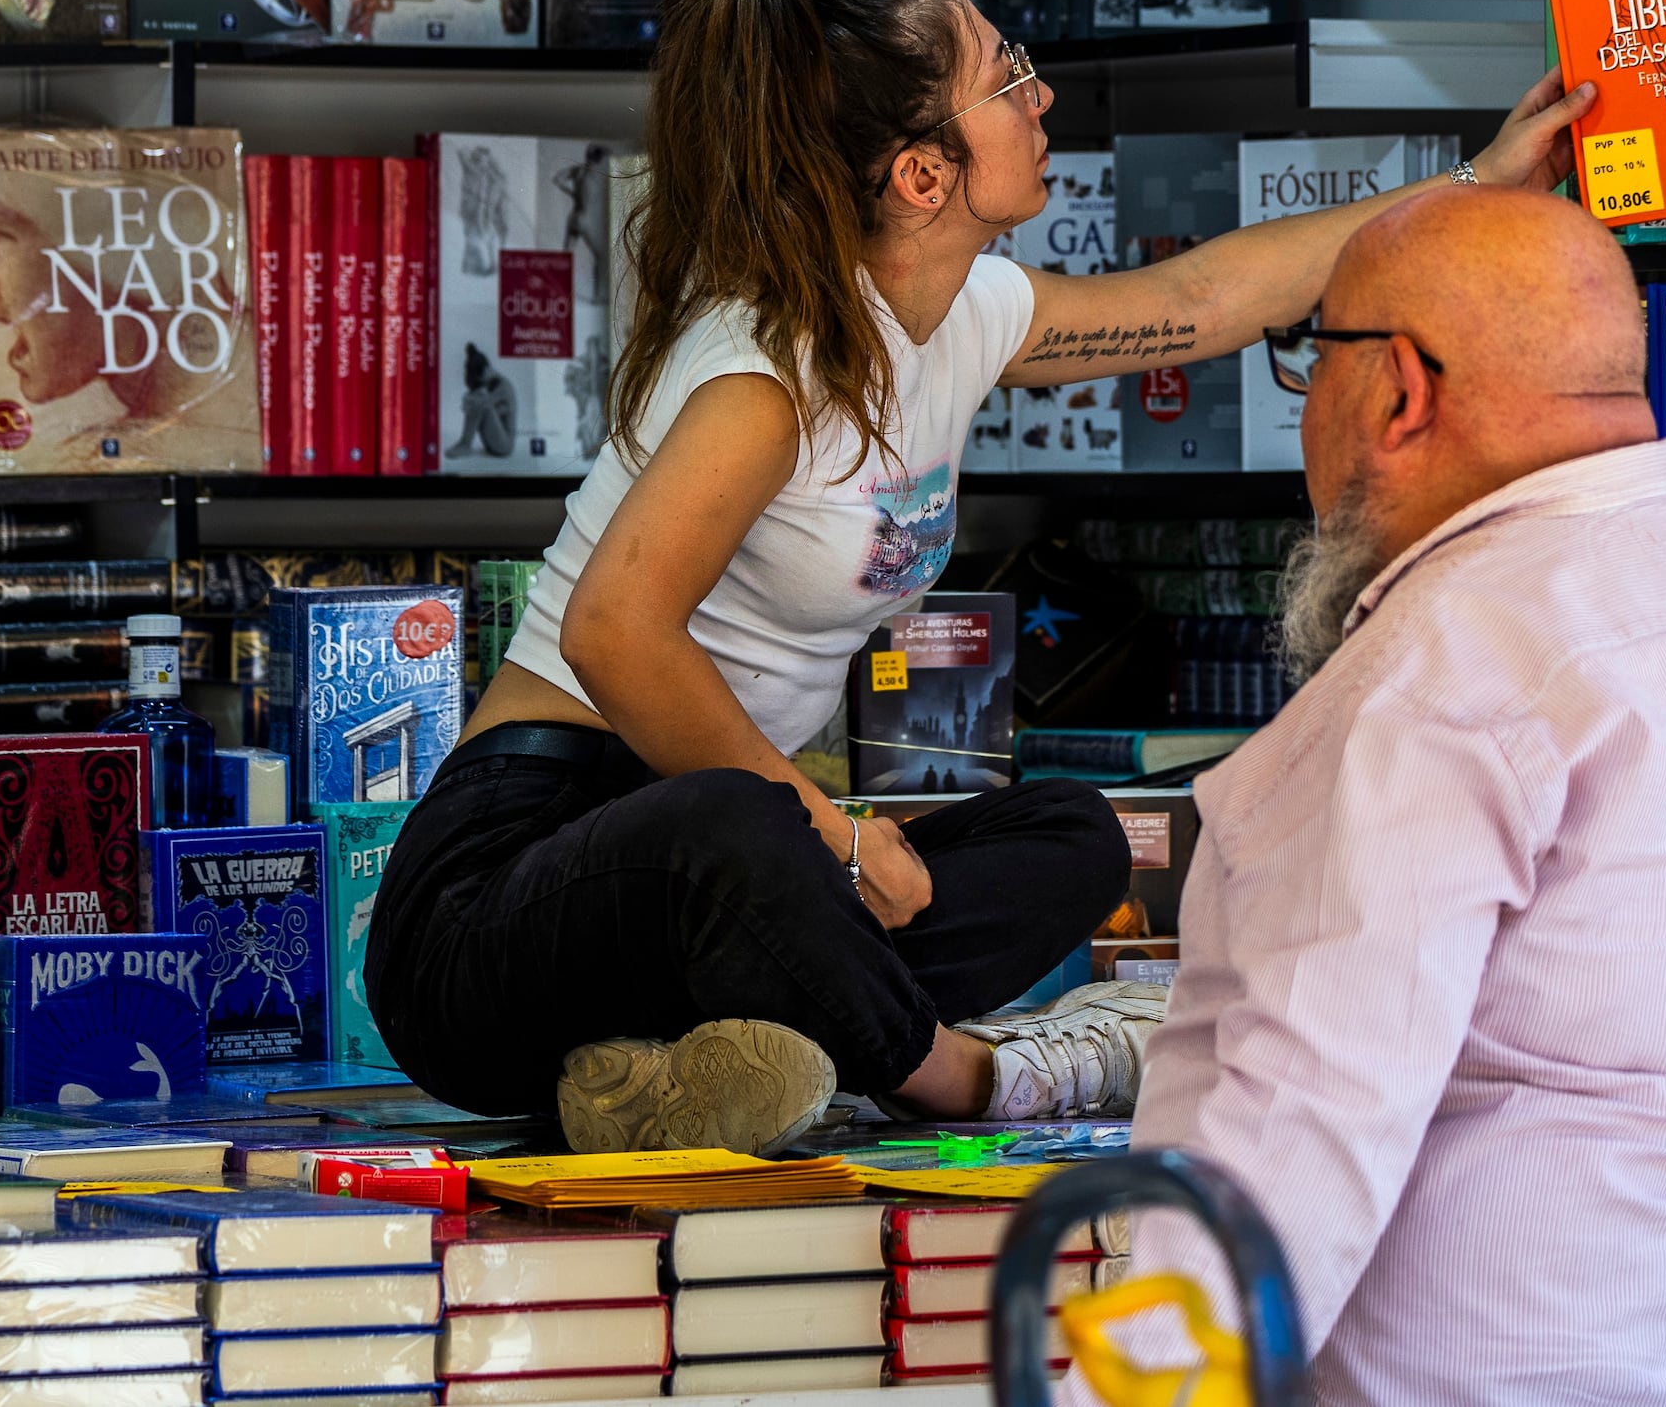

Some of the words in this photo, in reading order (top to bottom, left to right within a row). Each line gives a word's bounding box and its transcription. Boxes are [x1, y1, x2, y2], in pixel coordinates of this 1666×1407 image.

[1615, 32, 1640, 49] DEL
[1595, 140, 1613, 150] PVP
[1622, 137, 1637, 146] 12€
[71, 147, 119, 171] DEL
[130, 147, 226, 171] DIBUJO
[1258, 164, 1381, 209] FÓSILES
[1598, 190, 1652, 211] 10,80€
[53, 184, 222, 252] LEO
[41, 248, 232, 314] NAR
[503, 292, 570, 325] dibujo
[95, 309, 231, 375] DO
[1063, 330, 1078, 344] das
[1081, 327, 1106, 342] cuenta
[1109, 326, 1120, 341] de
[1121, 330, 1138, 342] que
[1139, 325, 1157, 340] todas
[1161, 319, 1173, 337] las
[1176, 324, 1195, 335] cosas
[910, 618, 925, 628] LAS
[927, 617, 973, 628] AVENTURAS
[310, 681, 362, 724] DOS
[367, 663, 458, 705] CIUDADES
[1125, 819, 1165, 827] AJEDREZ
[191, 861, 222, 885] LA
[226, 856, 306, 883] GUERRA
[205, 885, 220, 897] DE
[223, 884, 244, 895] LOS
[247, 881, 294, 894] MUNDOS
[12, 894, 37, 916] LA
[45, 891, 101, 915] LETRA
[5, 913, 109, 935] ESCARLATA
[31, 950, 112, 1011] MOBY
[123, 950, 203, 1011] DICK
